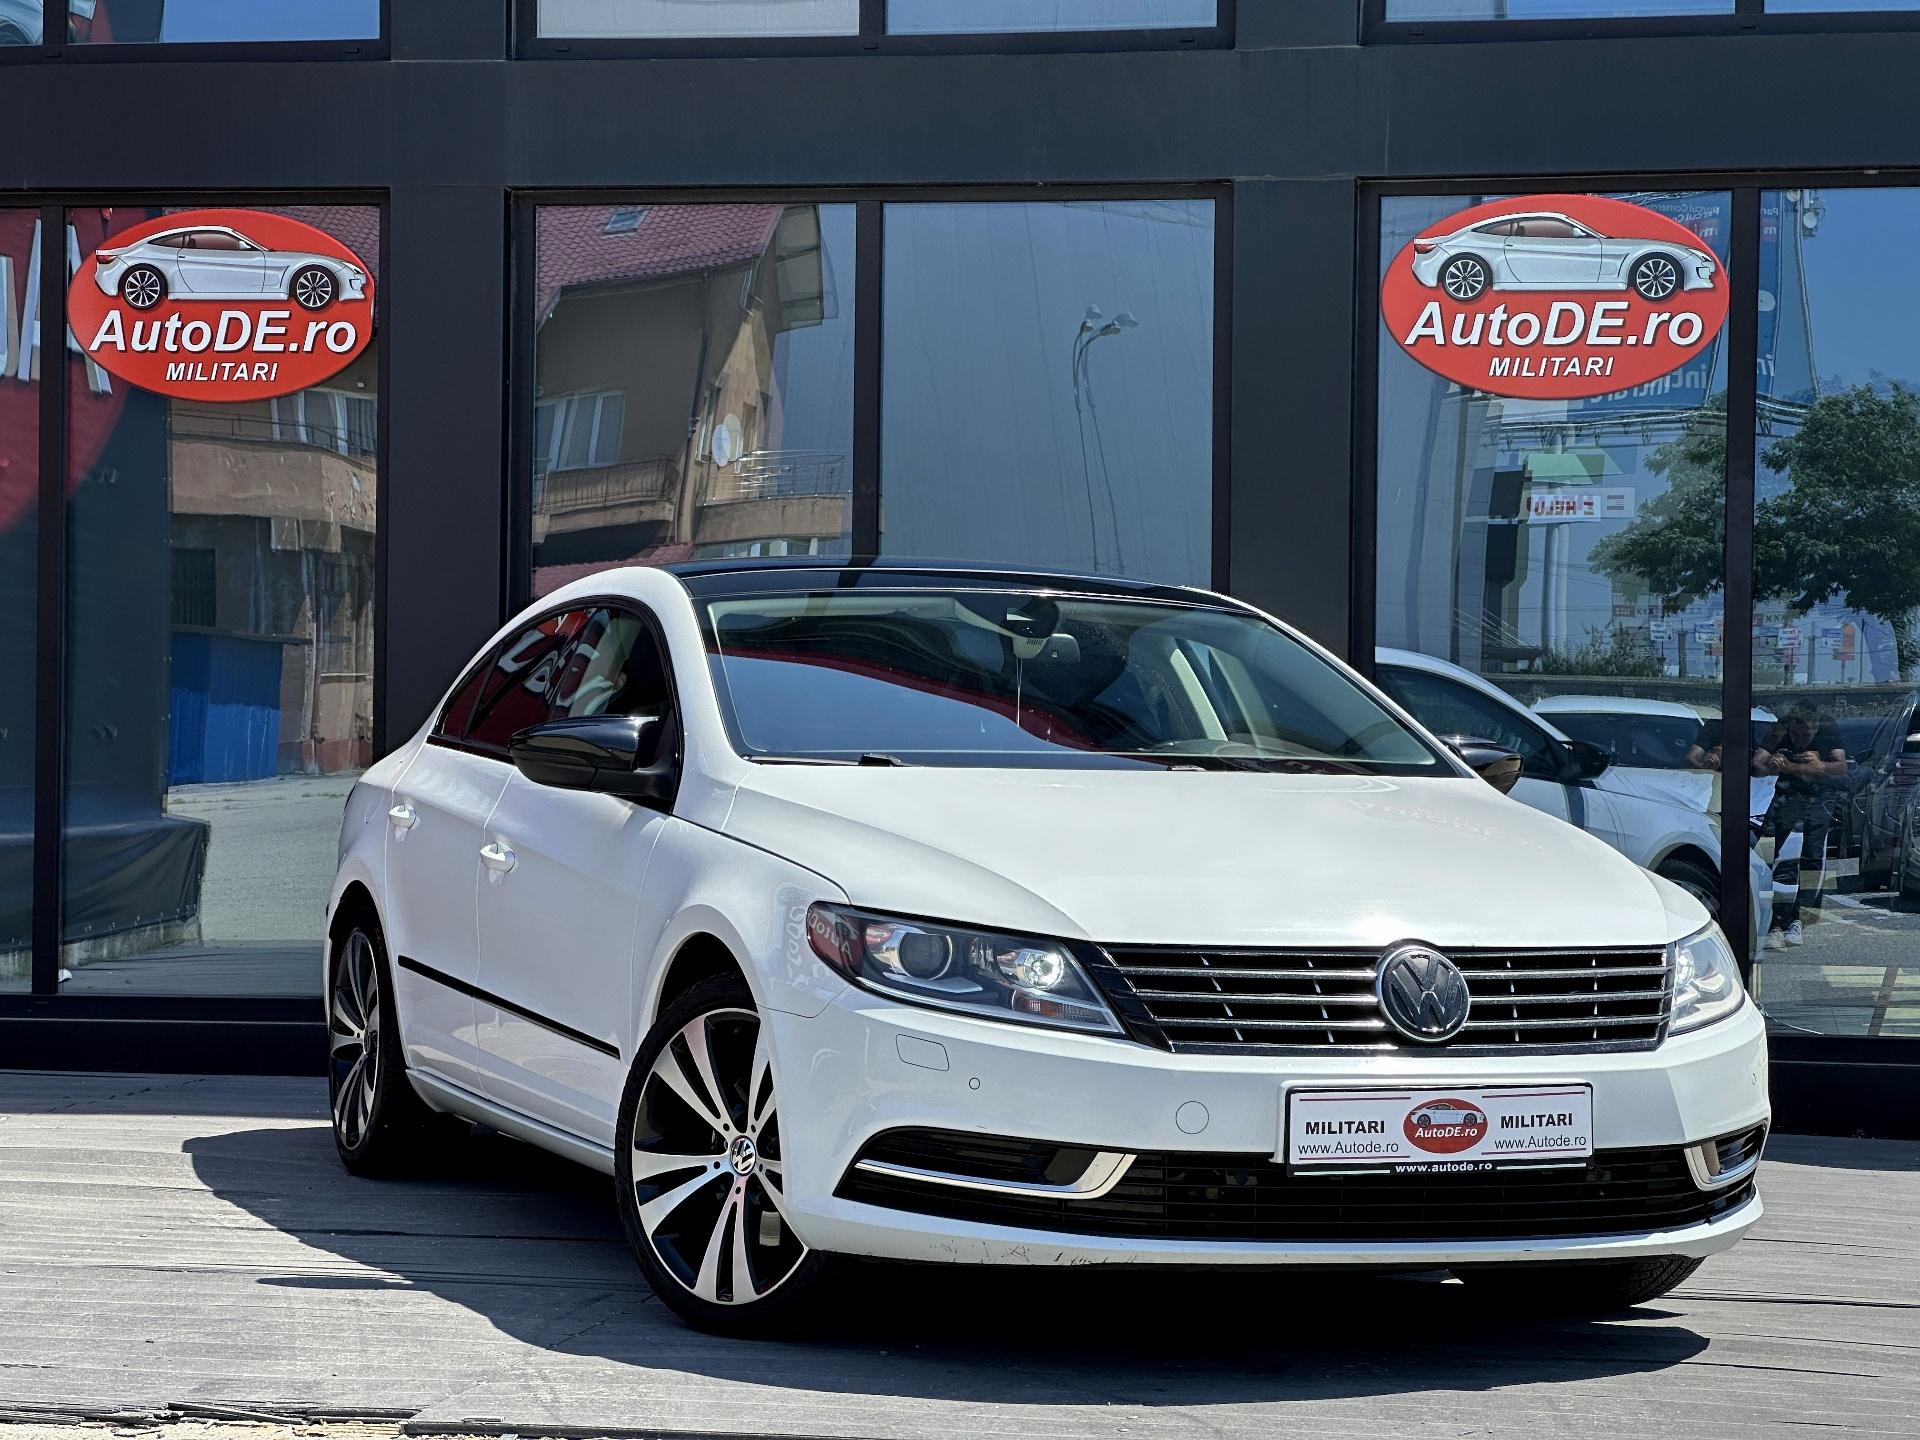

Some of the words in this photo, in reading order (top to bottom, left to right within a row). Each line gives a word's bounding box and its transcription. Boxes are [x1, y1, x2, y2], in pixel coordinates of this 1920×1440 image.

[89, 310, 356, 354] AutoDE.ro
[1404, 301, 1704, 347] AutoDE.ro
[165, 362, 278, 382] MILITARI
[1488, 356, 1615, 377] MILITARI
[1305, 1120, 1385, 1135] MILITARI
[1500, 1113, 1573, 1129] MILITARI
[1414, 1126, 1478, 1139] AutoDE.ro
[1298, 1141, 1399, 1155] www.Autode.ro
[1494, 1134, 1587, 1150] www.Autode.ro
[1395, 1161, 1493, 1173] www.autode.ro
